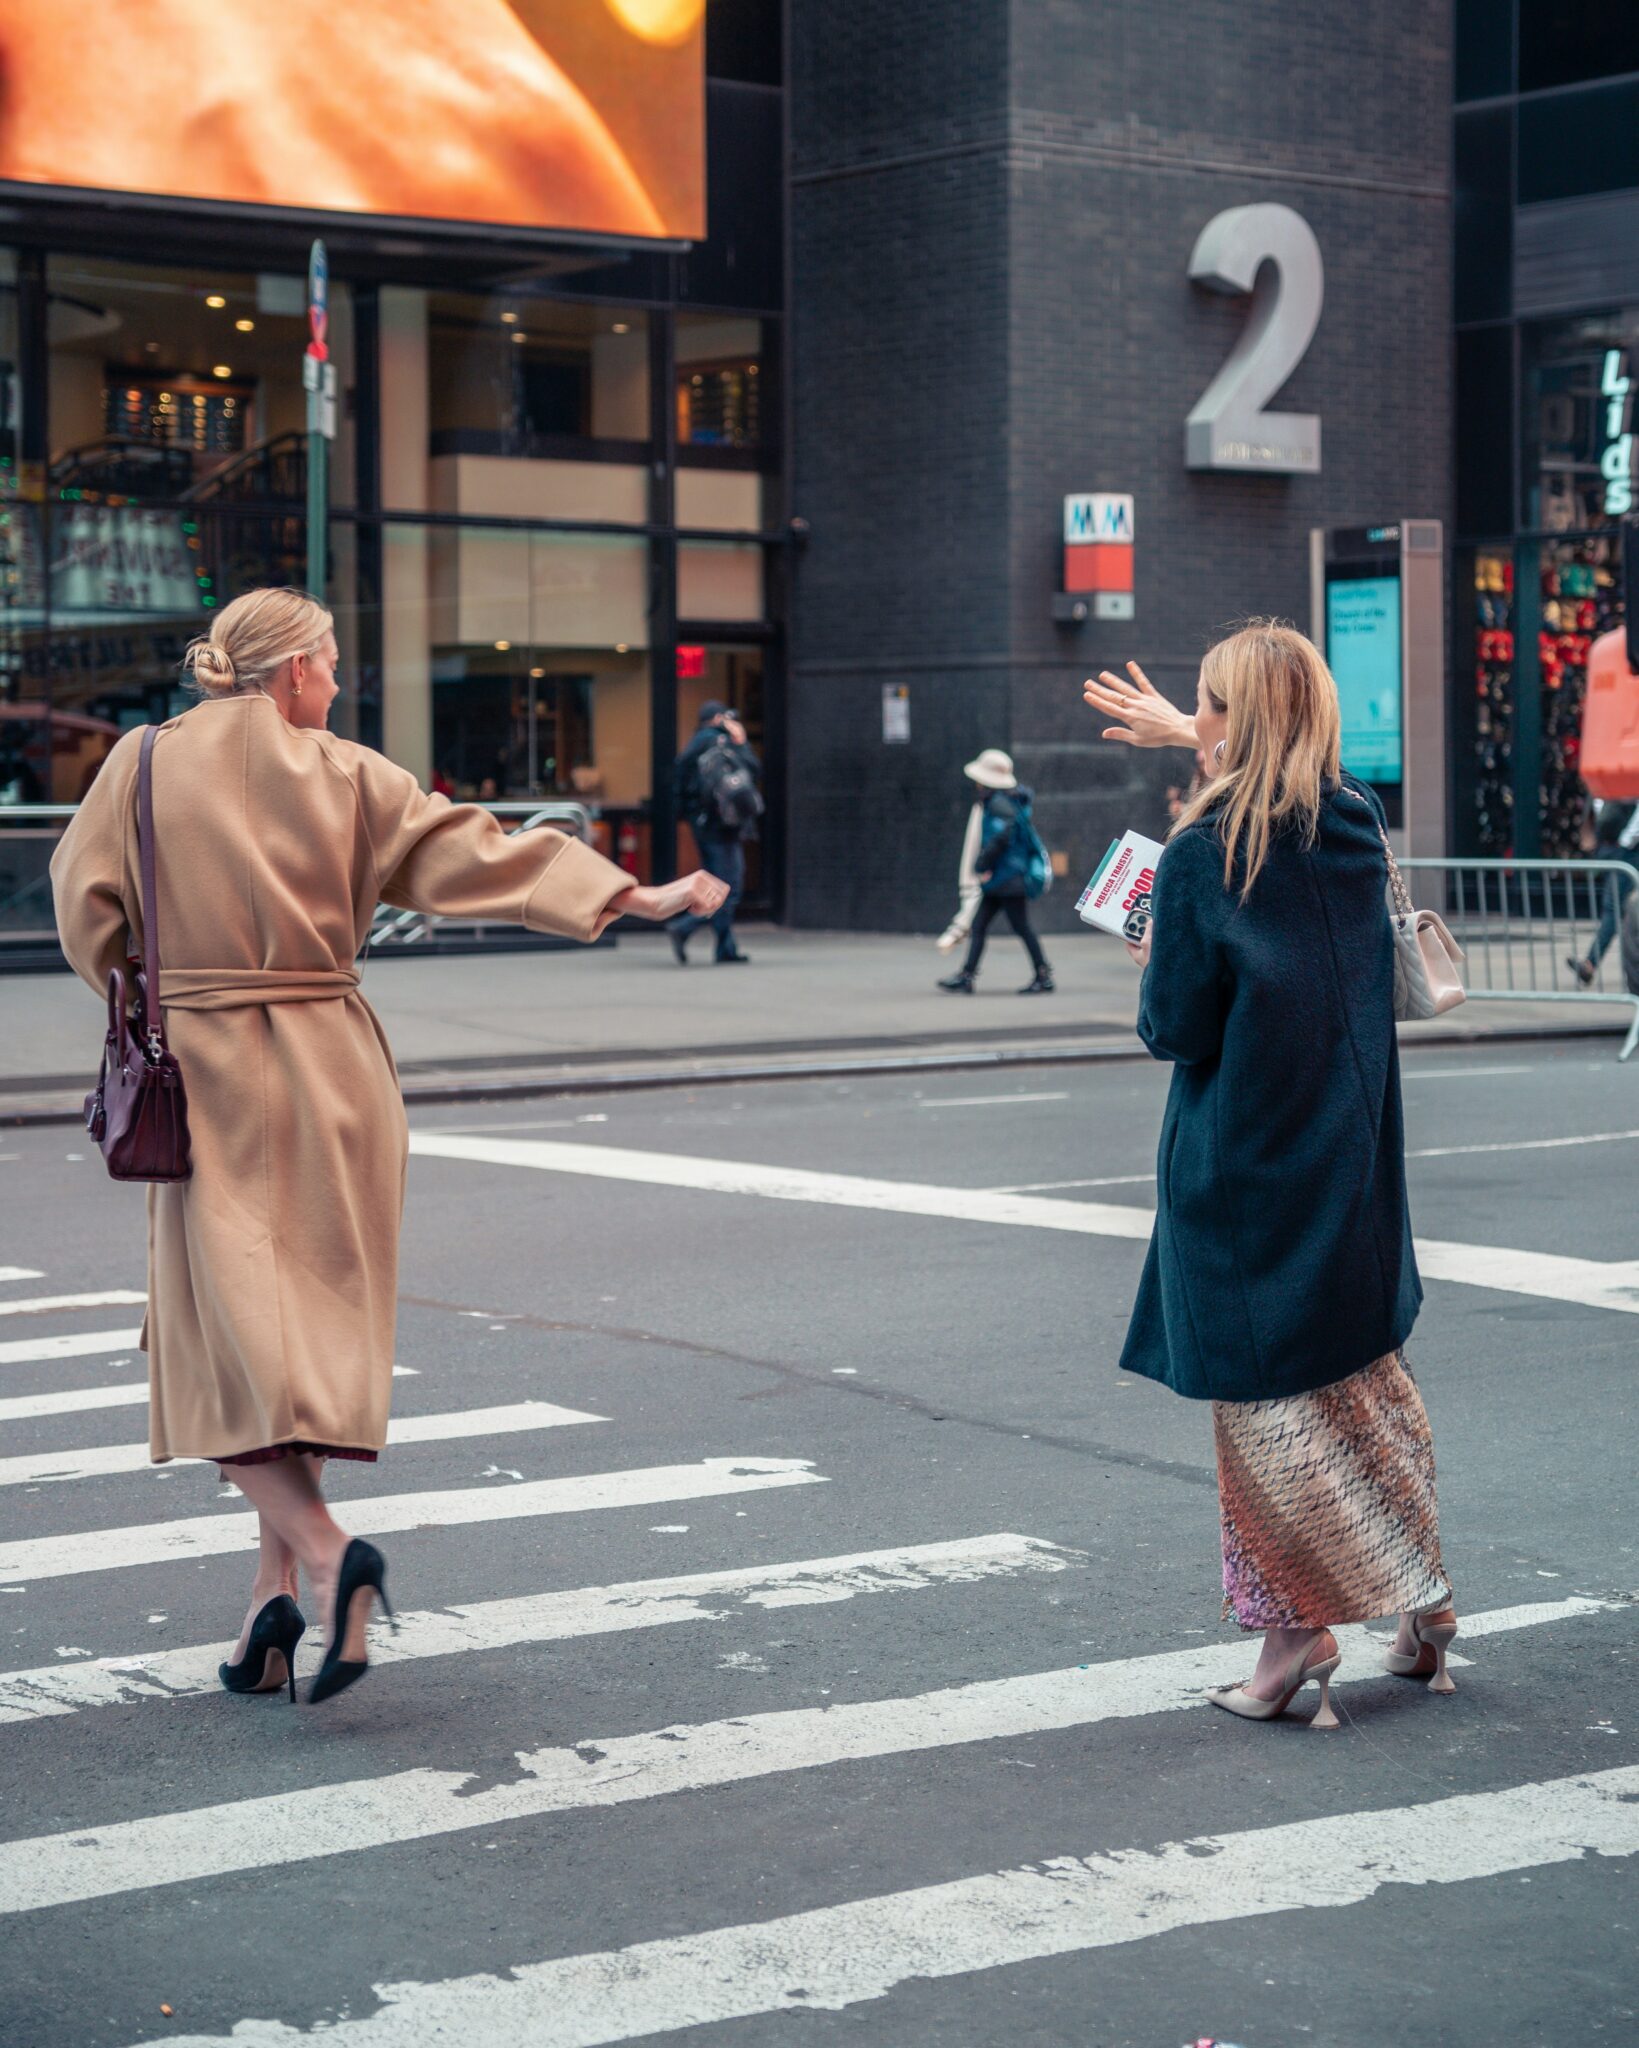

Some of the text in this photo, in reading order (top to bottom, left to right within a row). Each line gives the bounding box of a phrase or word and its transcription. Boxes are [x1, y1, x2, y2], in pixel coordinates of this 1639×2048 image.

[1186, 203, 1324, 472] 2
[1601, 350, 1633, 515] Lids
[1094, 878, 1115, 909] REBECCA
[1111, 847, 1134, 879] TRAISTER
